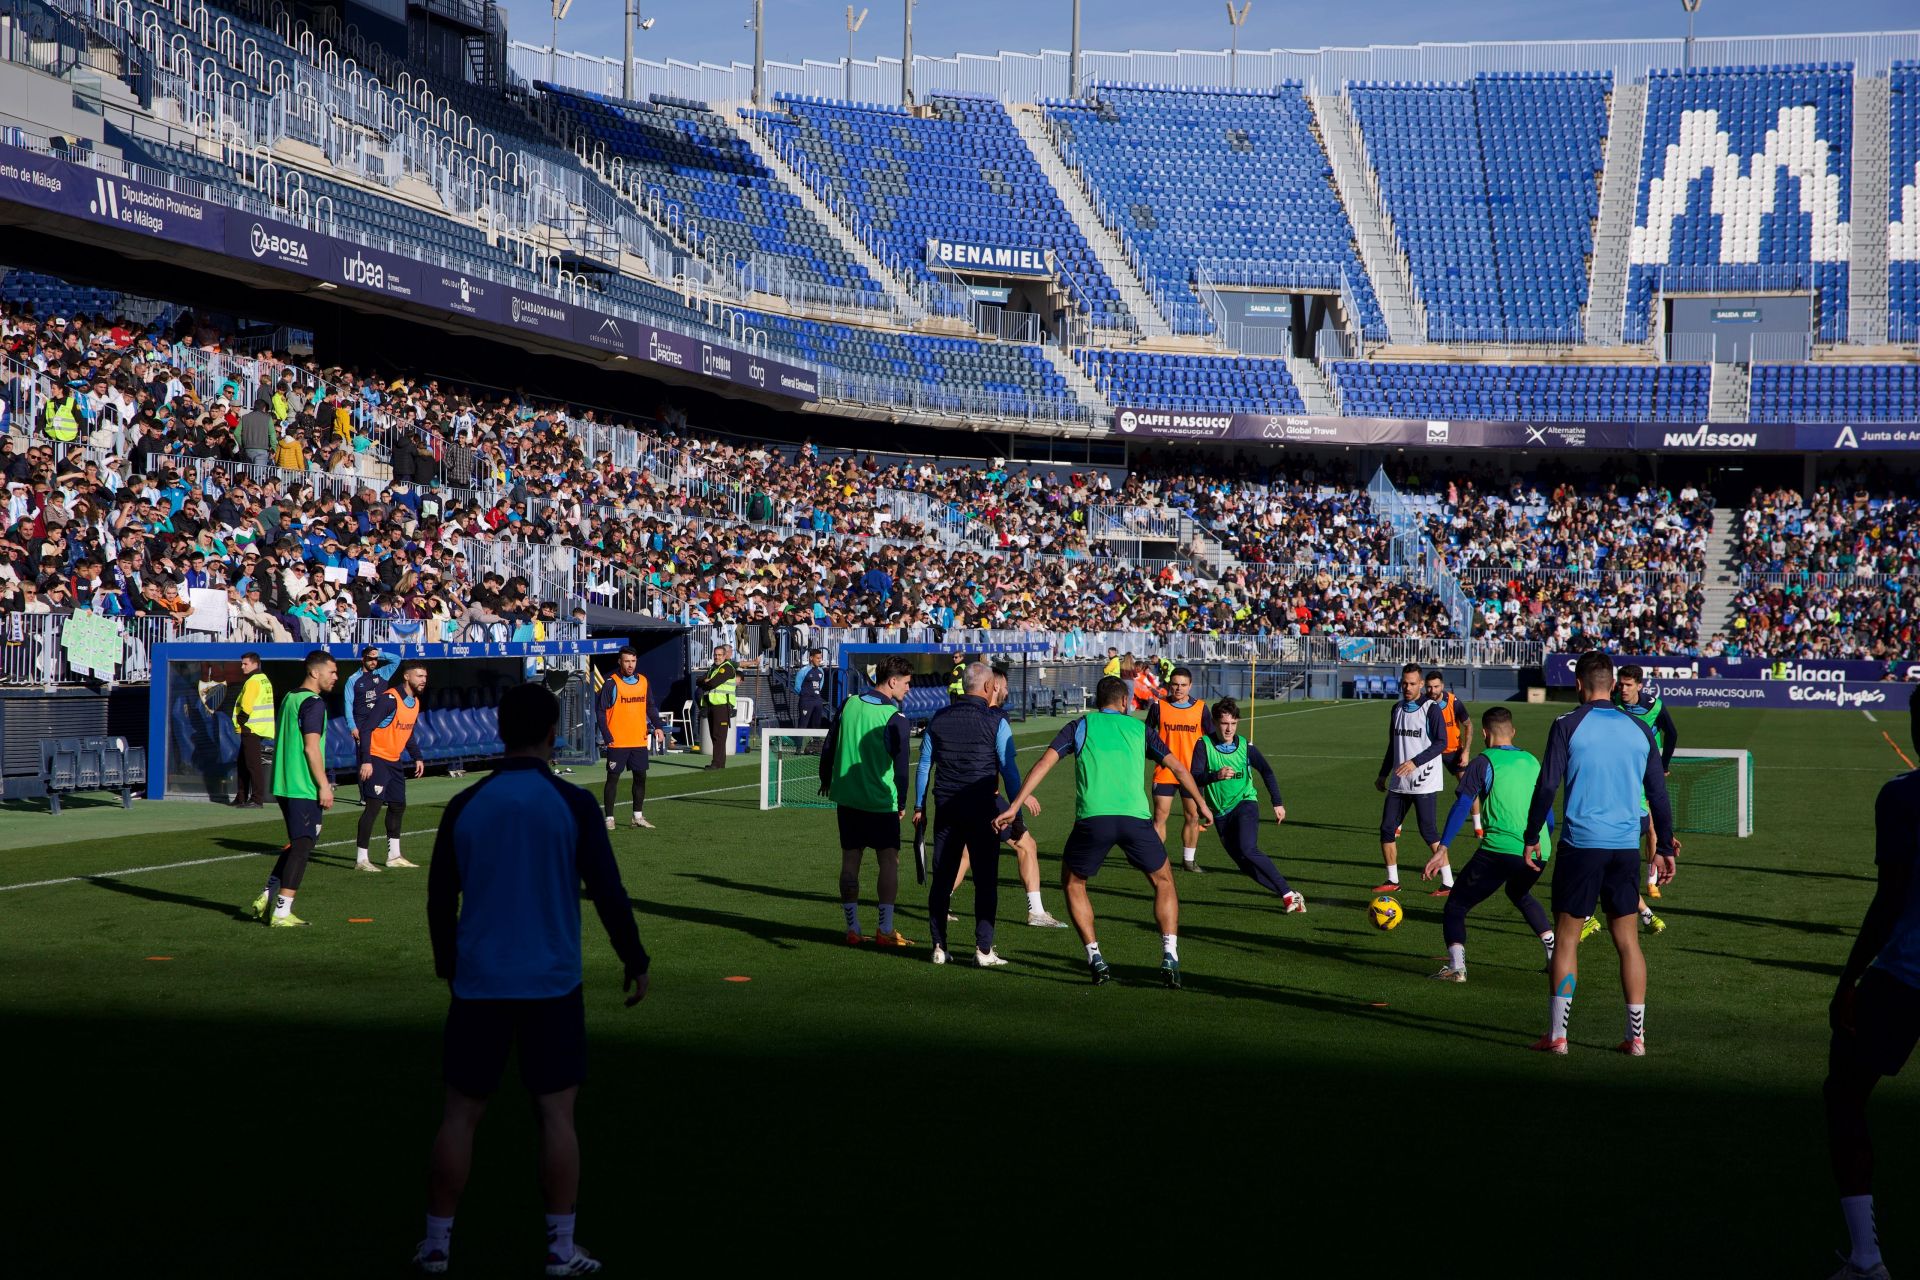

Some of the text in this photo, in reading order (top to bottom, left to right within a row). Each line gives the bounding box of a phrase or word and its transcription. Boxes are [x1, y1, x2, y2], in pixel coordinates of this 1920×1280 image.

[20, 168, 31, 182] de
[32, 170, 62, 192] Málaga
[122, 184, 202, 220] Diputación Provincial
[122, 207, 163, 232] de Málaga
[253, 230, 309, 260] TABOSA
[940, 243, 1044, 269] BENAMIEL
[343, 250, 384, 289] urbea
[658, 348, 682, 365] PROTEC
[780, 374, 795, 389] General
[1138, 414, 1171, 426] CAFFE
[1286, 426, 1336, 435] Global Travel
[1663, 424, 1757, 446] NAVISSON
[1861, 431, 1891, 440] Junta
[1893, 431, 1907, 440] de
[1663, 686, 1765, 698] DOÑA FRANCISQUITA
[1804, 686, 1836, 701] Corte
[1698, 700, 1730, 708] catering
[1164, 722, 1198, 732] hummel
